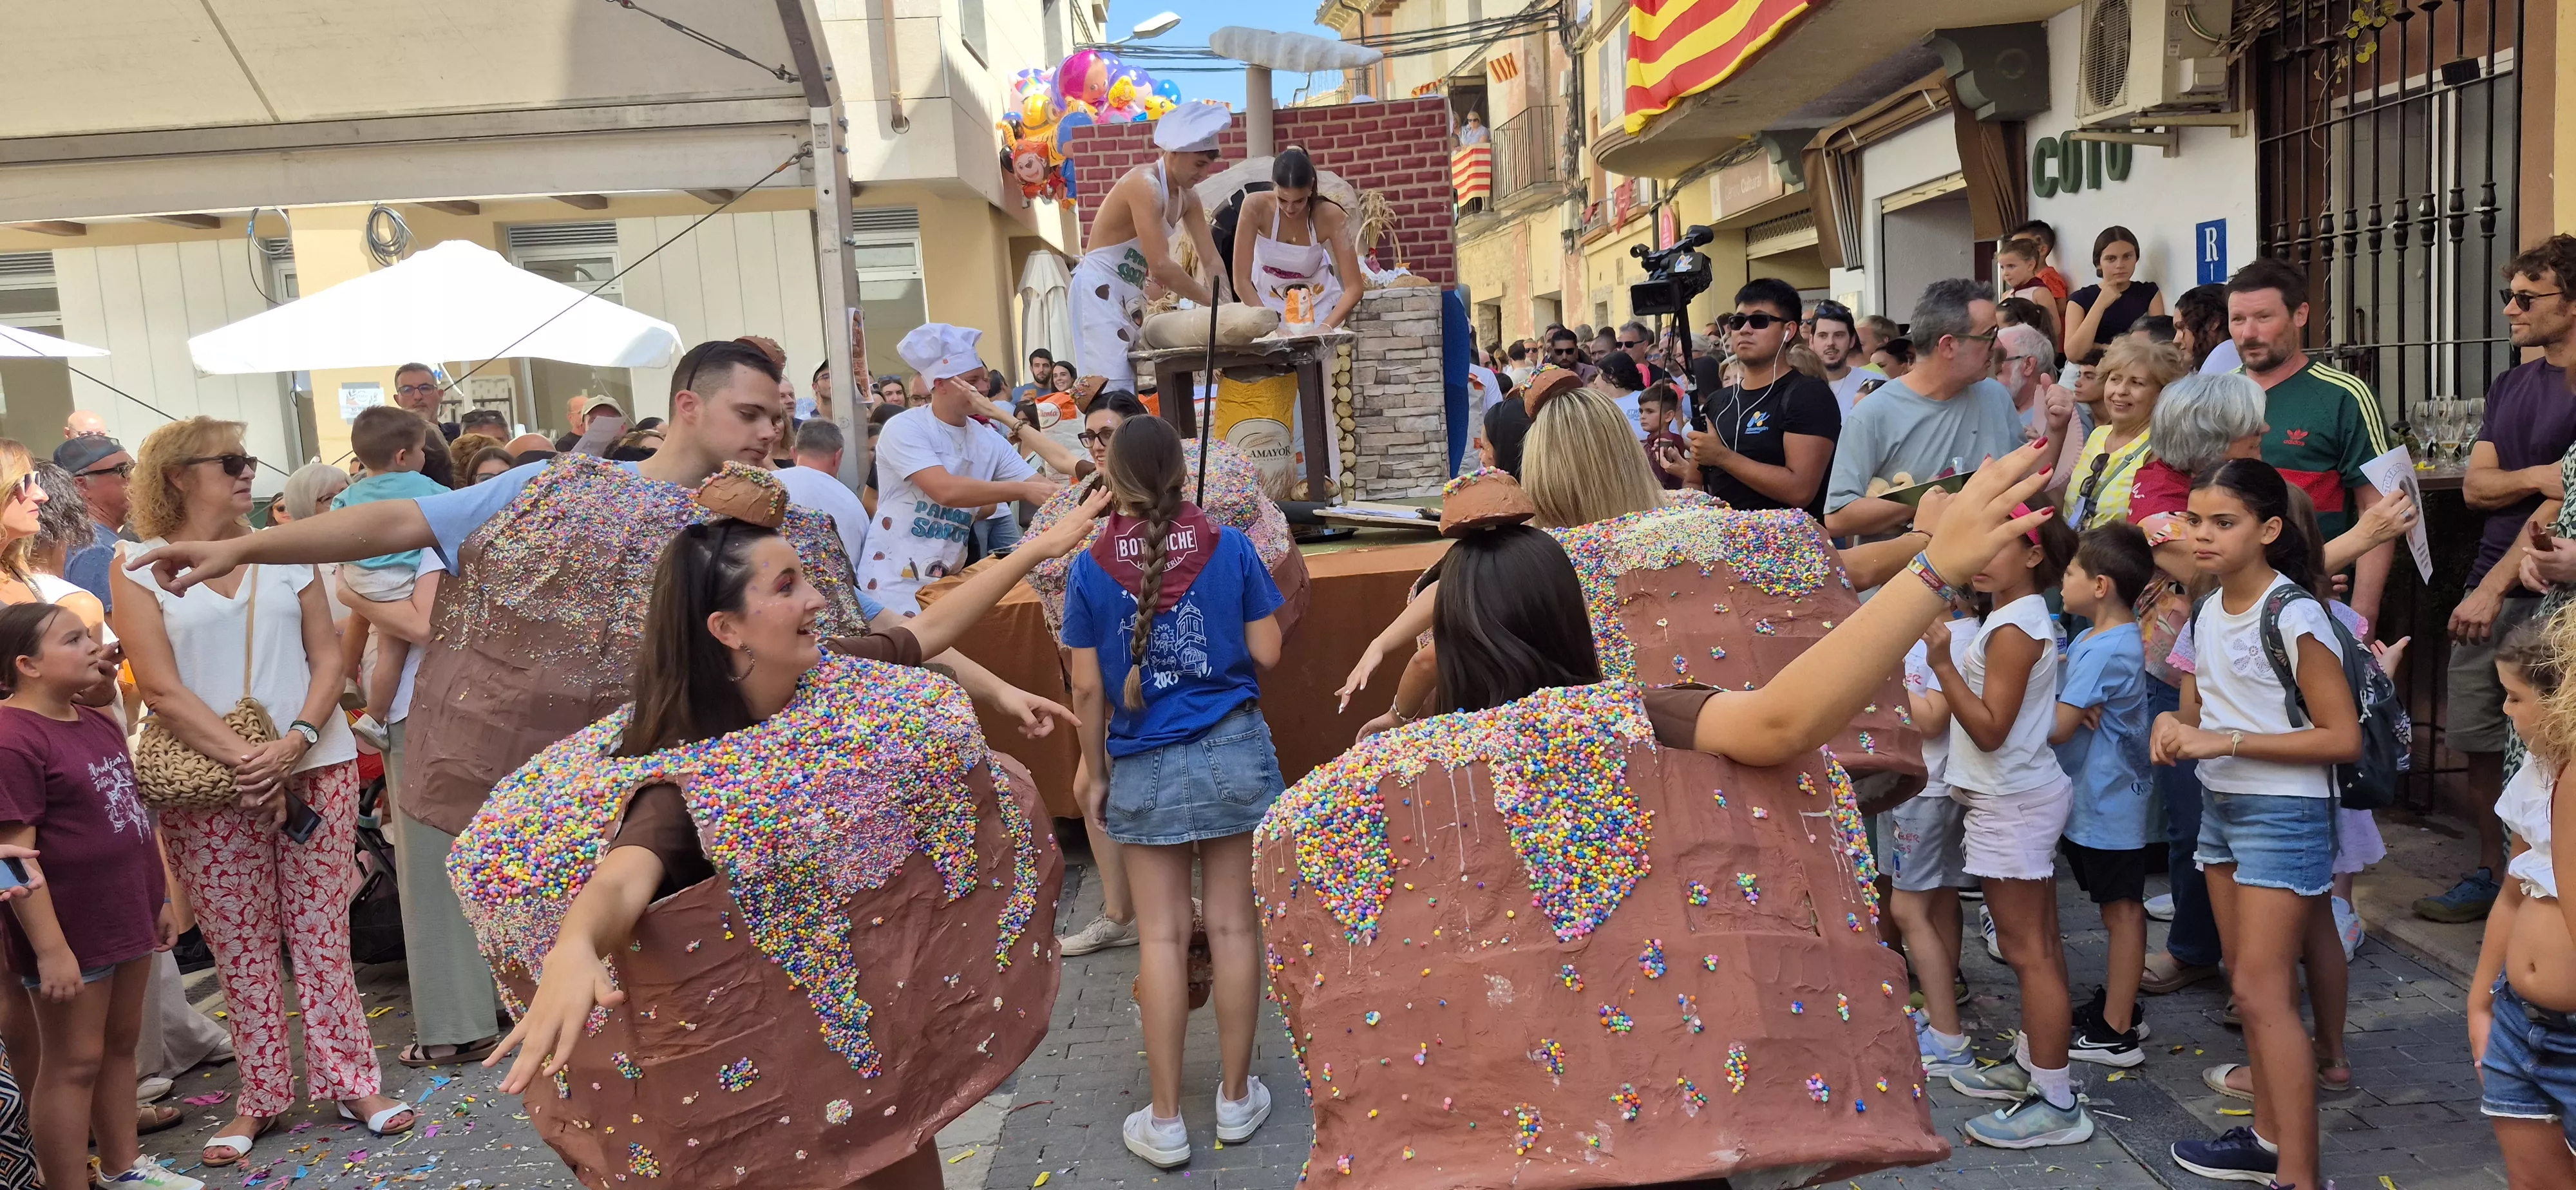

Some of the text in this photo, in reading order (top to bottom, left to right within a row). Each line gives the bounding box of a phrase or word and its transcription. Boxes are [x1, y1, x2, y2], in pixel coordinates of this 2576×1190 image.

[2032, 130, 2132, 198] COTO
[1741, 170, 1762, 194] Cultural
[2204, 227, 2219, 261] R
[1119, 531, 1195, 557] BOTICHE
